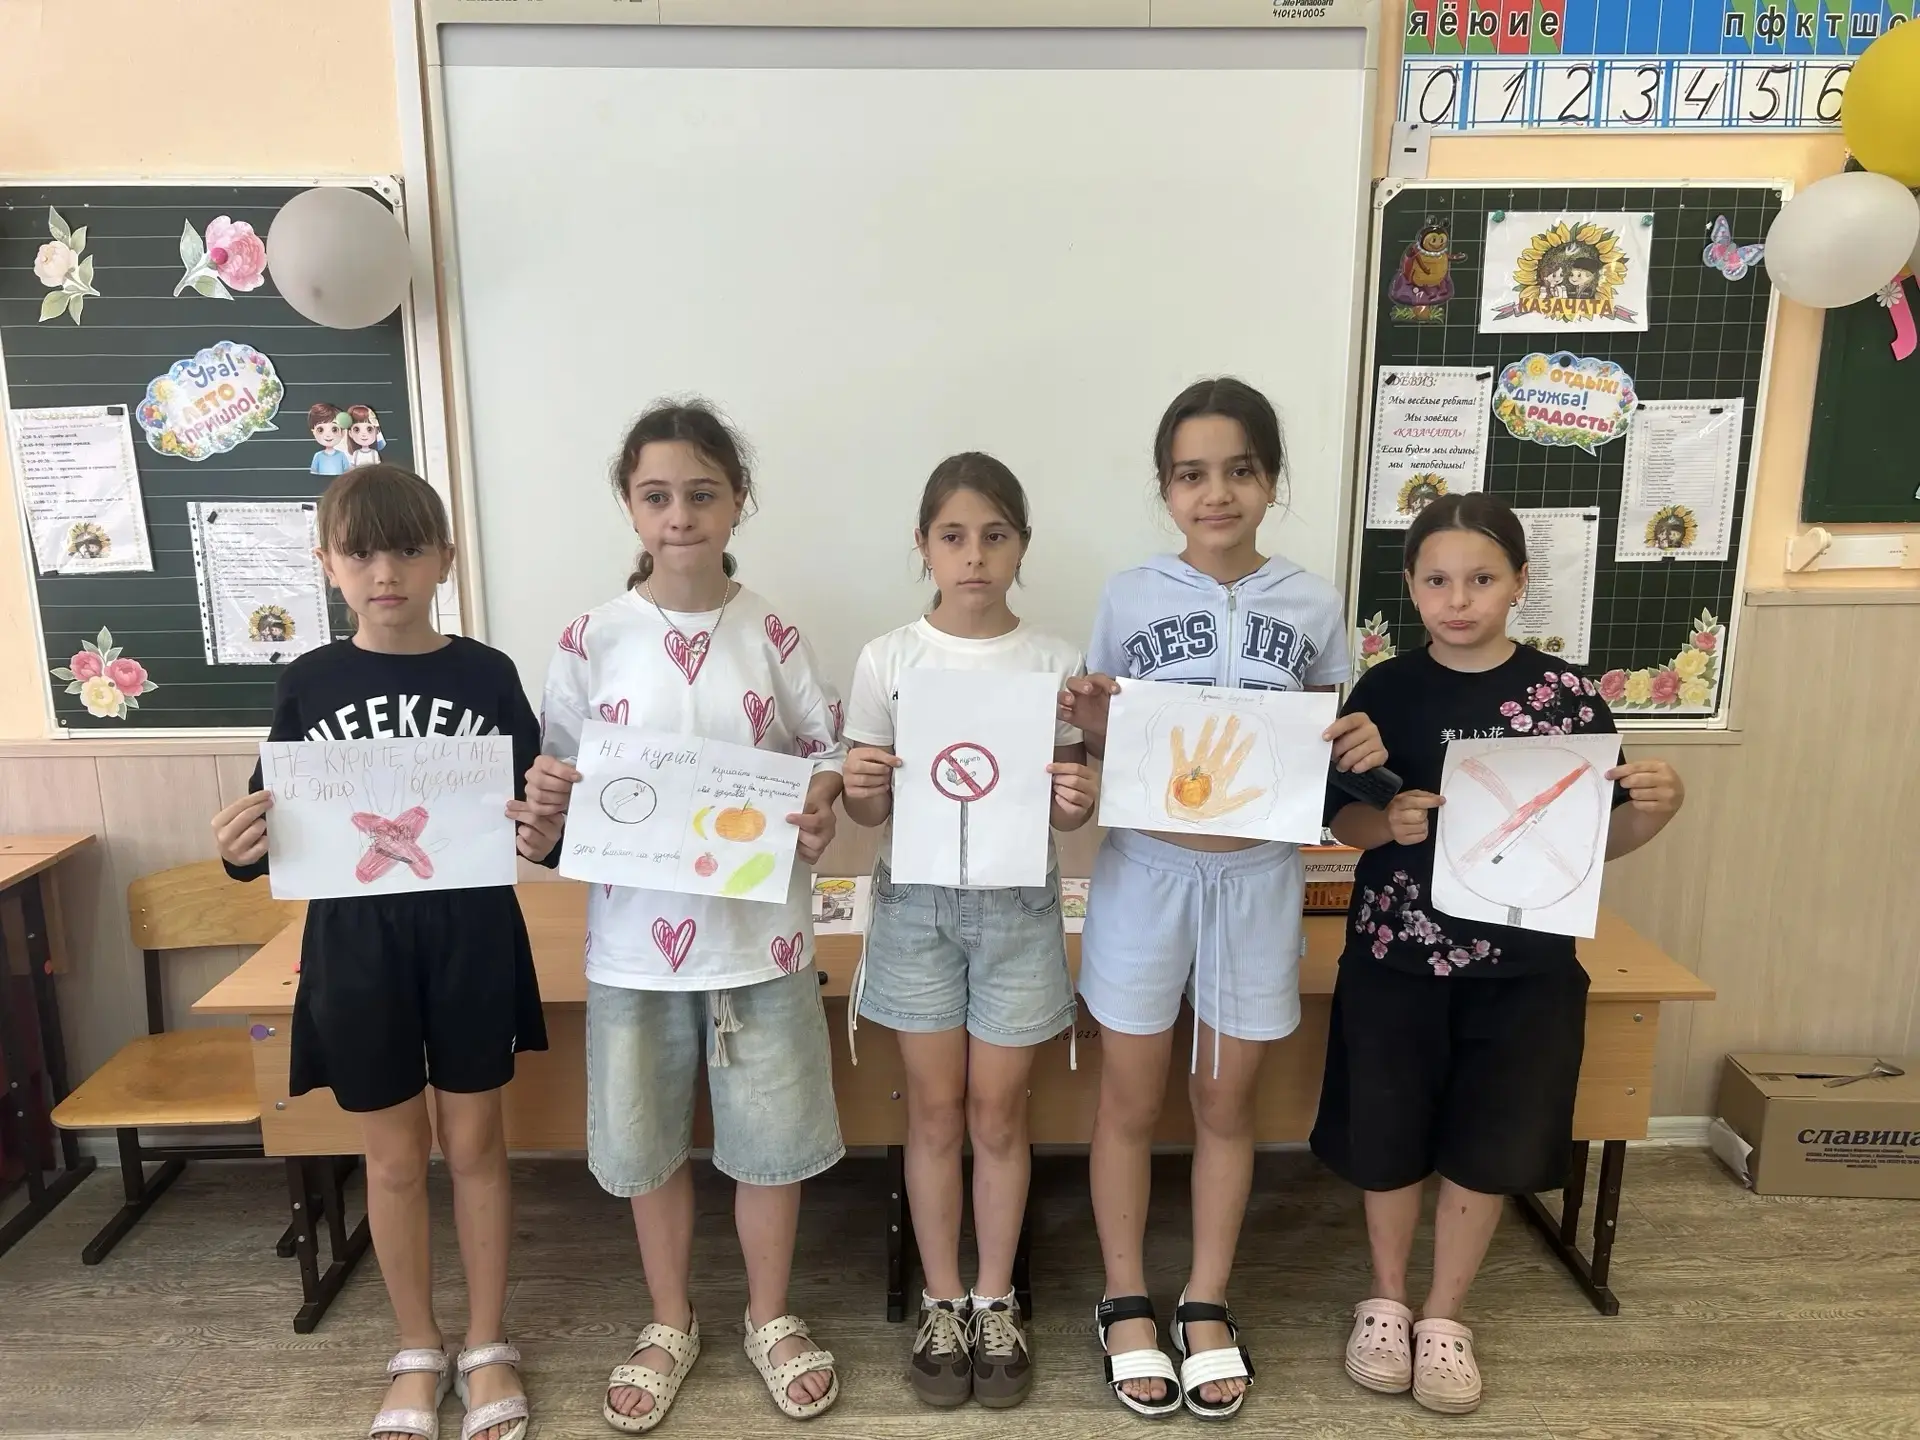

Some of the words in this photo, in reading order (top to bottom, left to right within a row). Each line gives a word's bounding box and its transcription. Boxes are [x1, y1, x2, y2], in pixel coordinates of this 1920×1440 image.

[1407, 11, 1428, 36] я
[1439, 3, 1458, 36] ё
[1469, 11, 1498, 36] ю
[1508, 11, 1530, 36] и
[1540, 11, 1560, 36] е
[1724, 13, 1745, 37] п
[1756, 5, 1786, 44] ф
[1795, 13, 1813, 37] к
[1825, 13, 1844, 37] т
[1851, 14, 1880, 37] ш
[1501, 68, 1529, 122] 1
[1557, 66, 1593, 122] 2
[1622, 66, 1660, 122] 3
[1684, 67, 1720, 120] 4
[1748, 65, 1791, 121] 5
[1816, 66, 1852, 121] 6
[1517, 297, 1614, 317] КАЗАЧАТА
[1549, 368, 1620, 395] ОТДЫХ!
[182, 383, 236, 425] ЛЕТО
[1388, 395, 1406, 405] Мы
[1407, 396, 1441, 405] весёлые
[1441, 395, 1477, 408] ребята!
[1403, 413, 1421, 423] Мы
[1423, 413, 1458, 423] зовёмся
[1527, 405, 1616, 434] РАДОСТЬ!
[1381, 444, 1403, 454] Если
[1405, 444, 1431, 457] будем
[1432, 447, 1448, 455] мы
[1388, 461, 1403, 469] мы
[1410, 459, 1466, 470] непобедимы!
[1122, 610, 1219, 680] DES
[303, 694, 501, 742] EEKEN
[599, 739, 626, 758] НЕ
[1440, 726, 1505, 745] 美しい花
[271, 743, 311, 778] НЕ
